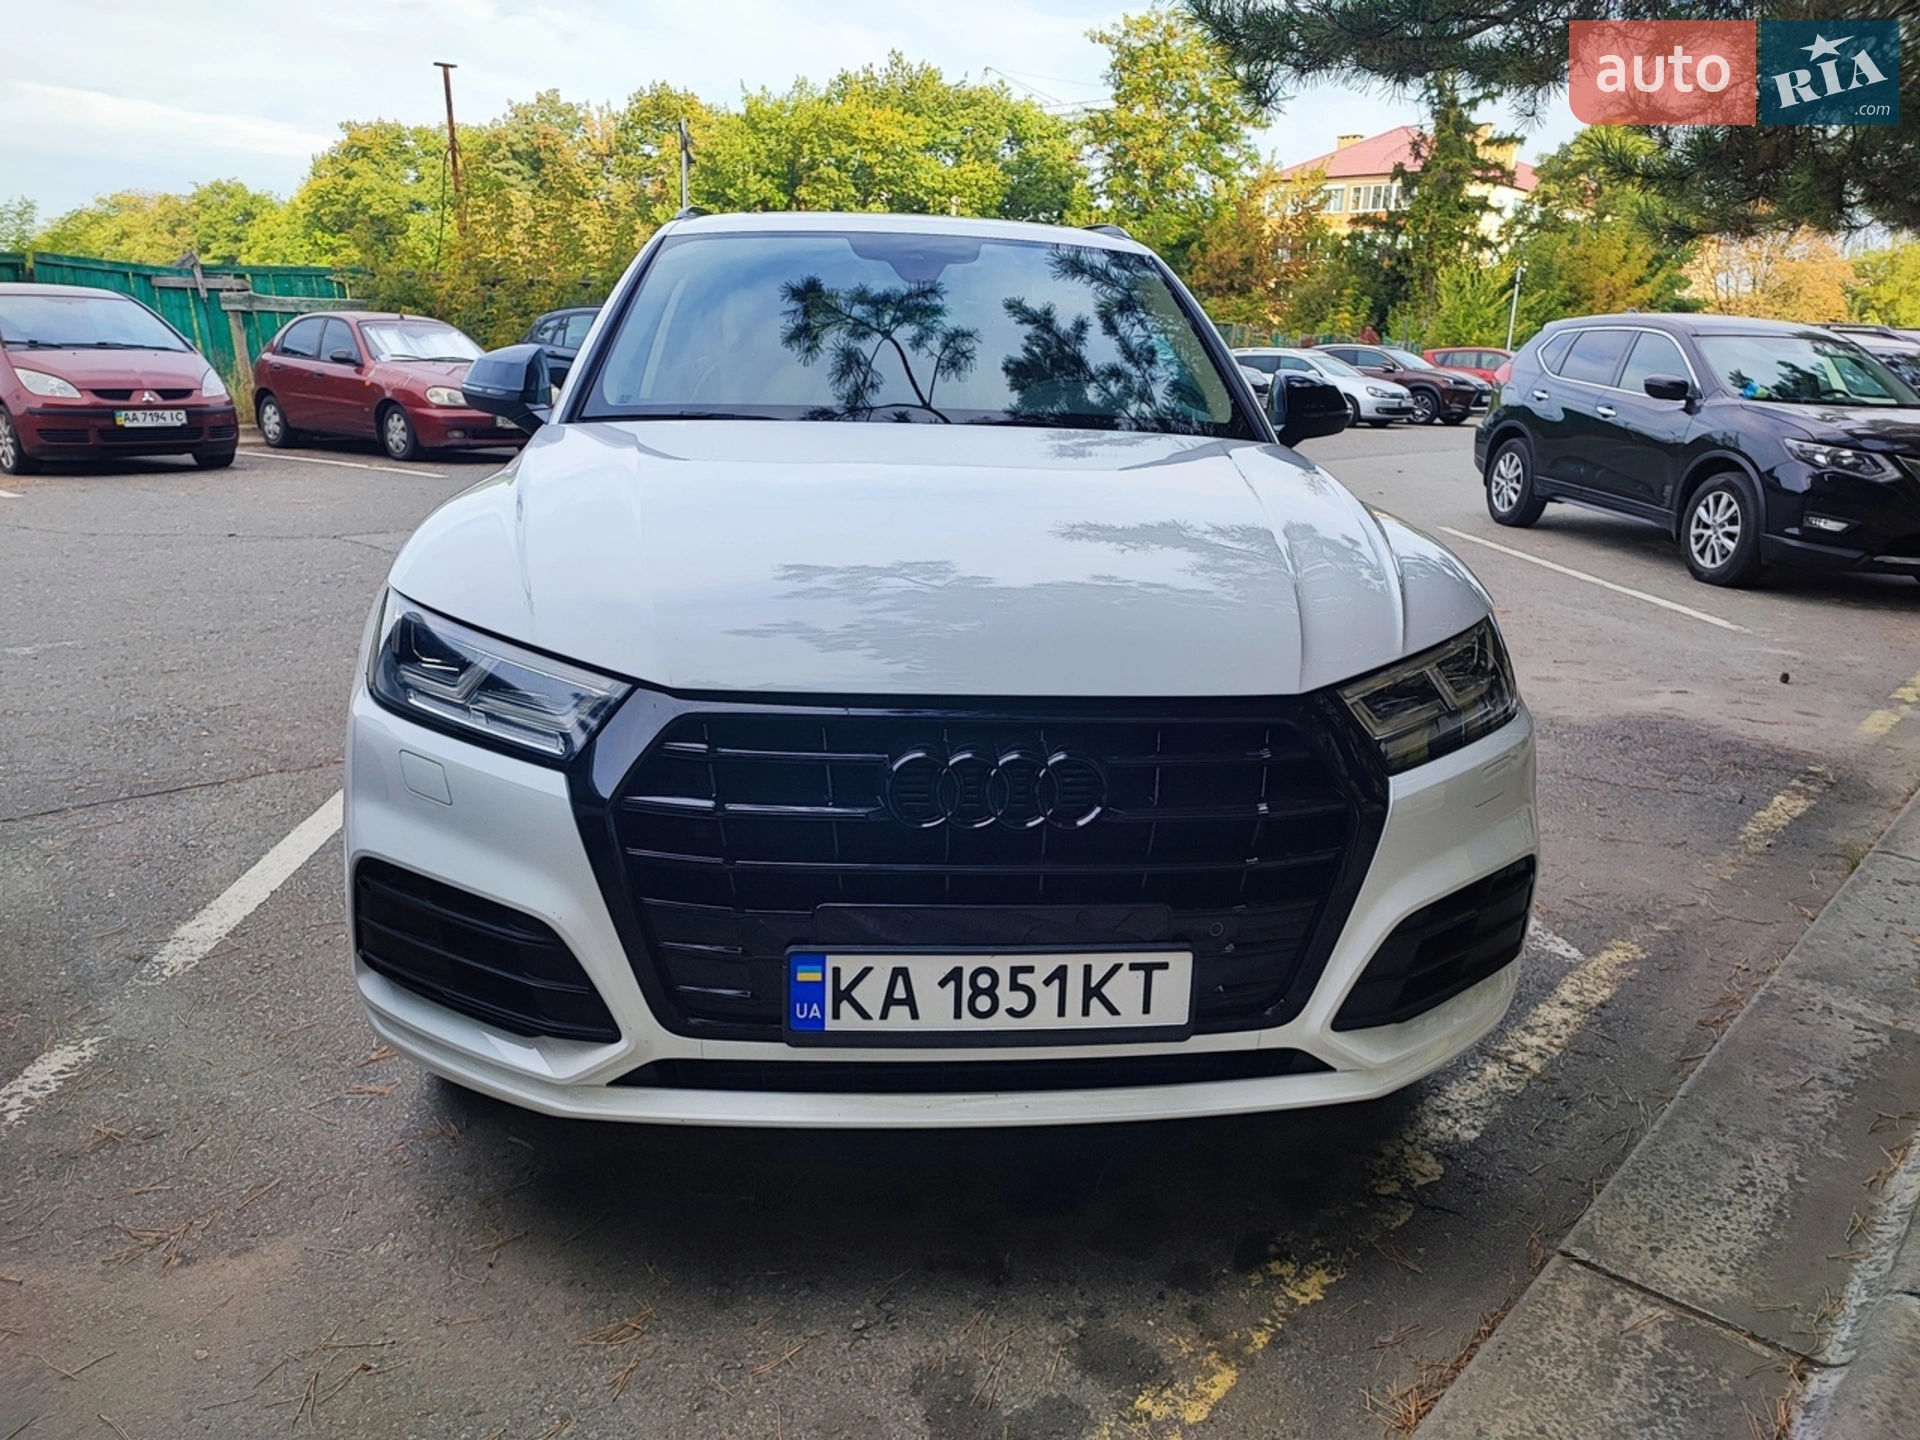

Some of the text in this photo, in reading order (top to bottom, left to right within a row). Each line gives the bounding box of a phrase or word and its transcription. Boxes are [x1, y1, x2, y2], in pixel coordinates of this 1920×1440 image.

[124, 412, 184, 422] AA 7194 IC
[831, 962, 1170, 1021] KA 1851 KT
[795, 1002, 821, 1020] UA
